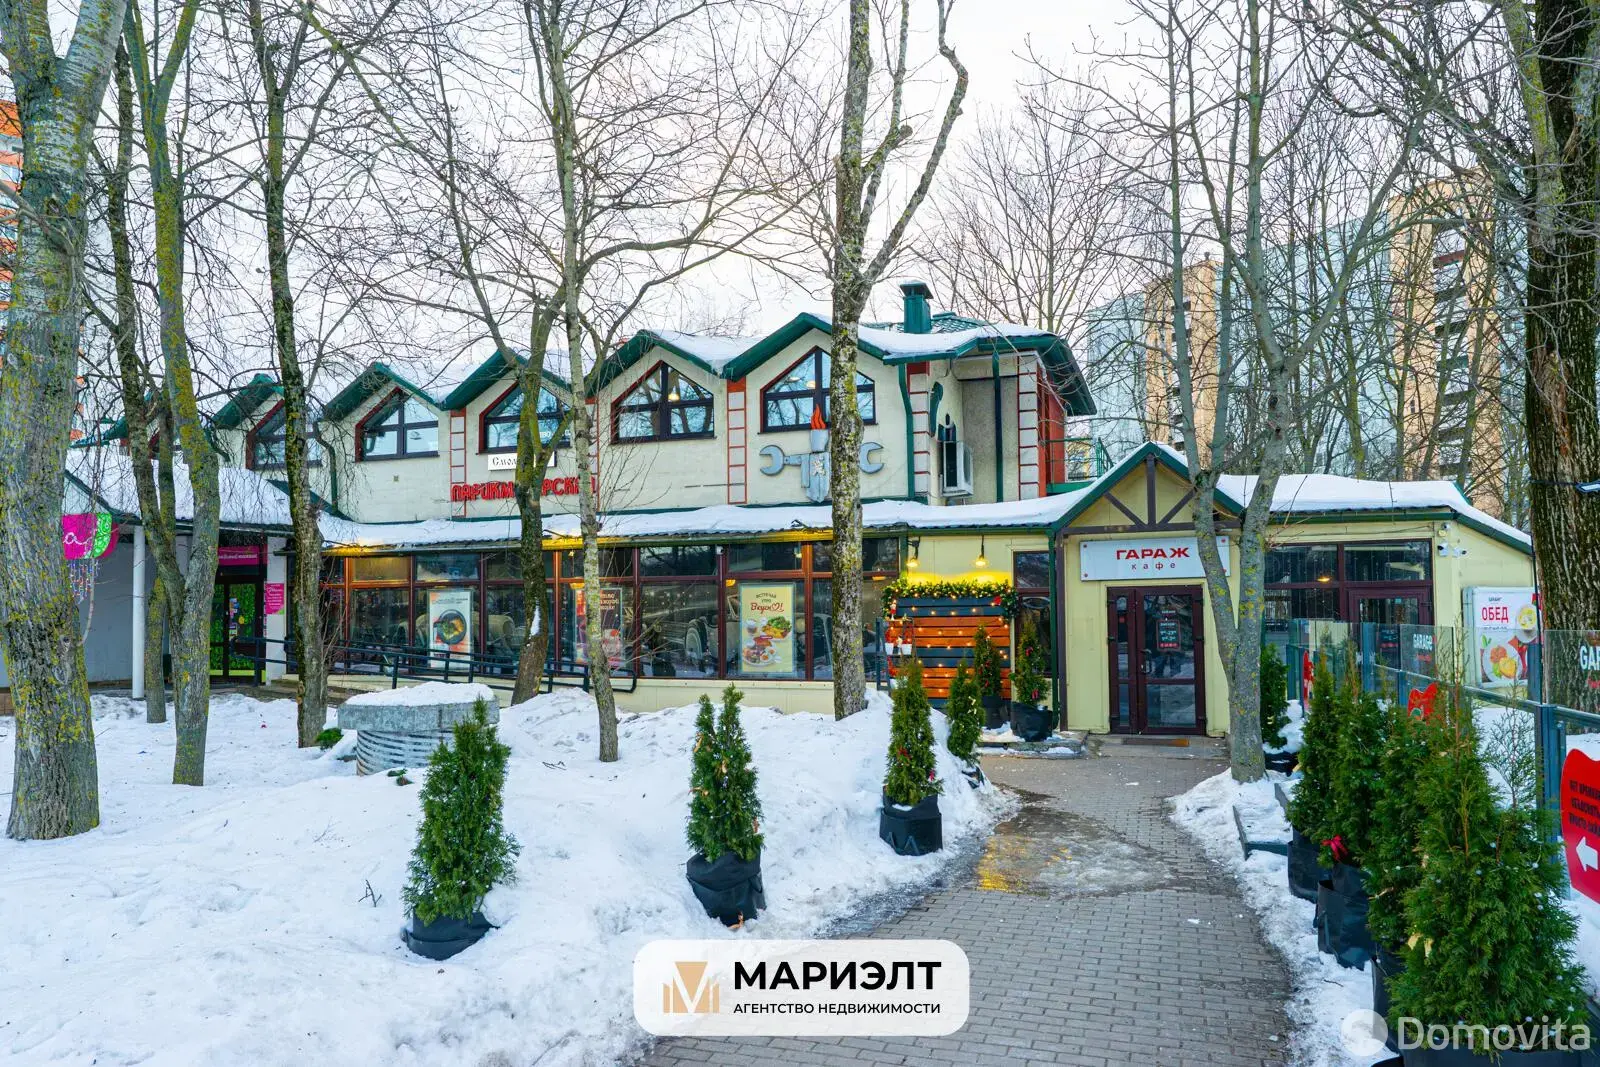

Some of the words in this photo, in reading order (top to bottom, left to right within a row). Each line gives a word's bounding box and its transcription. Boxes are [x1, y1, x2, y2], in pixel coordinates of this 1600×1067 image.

[1116, 547, 1190, 560] ГАРАЖ
[1131, 562, 1176, 571] кафе
[1482, 606, 1509, 623] ОБЕД
